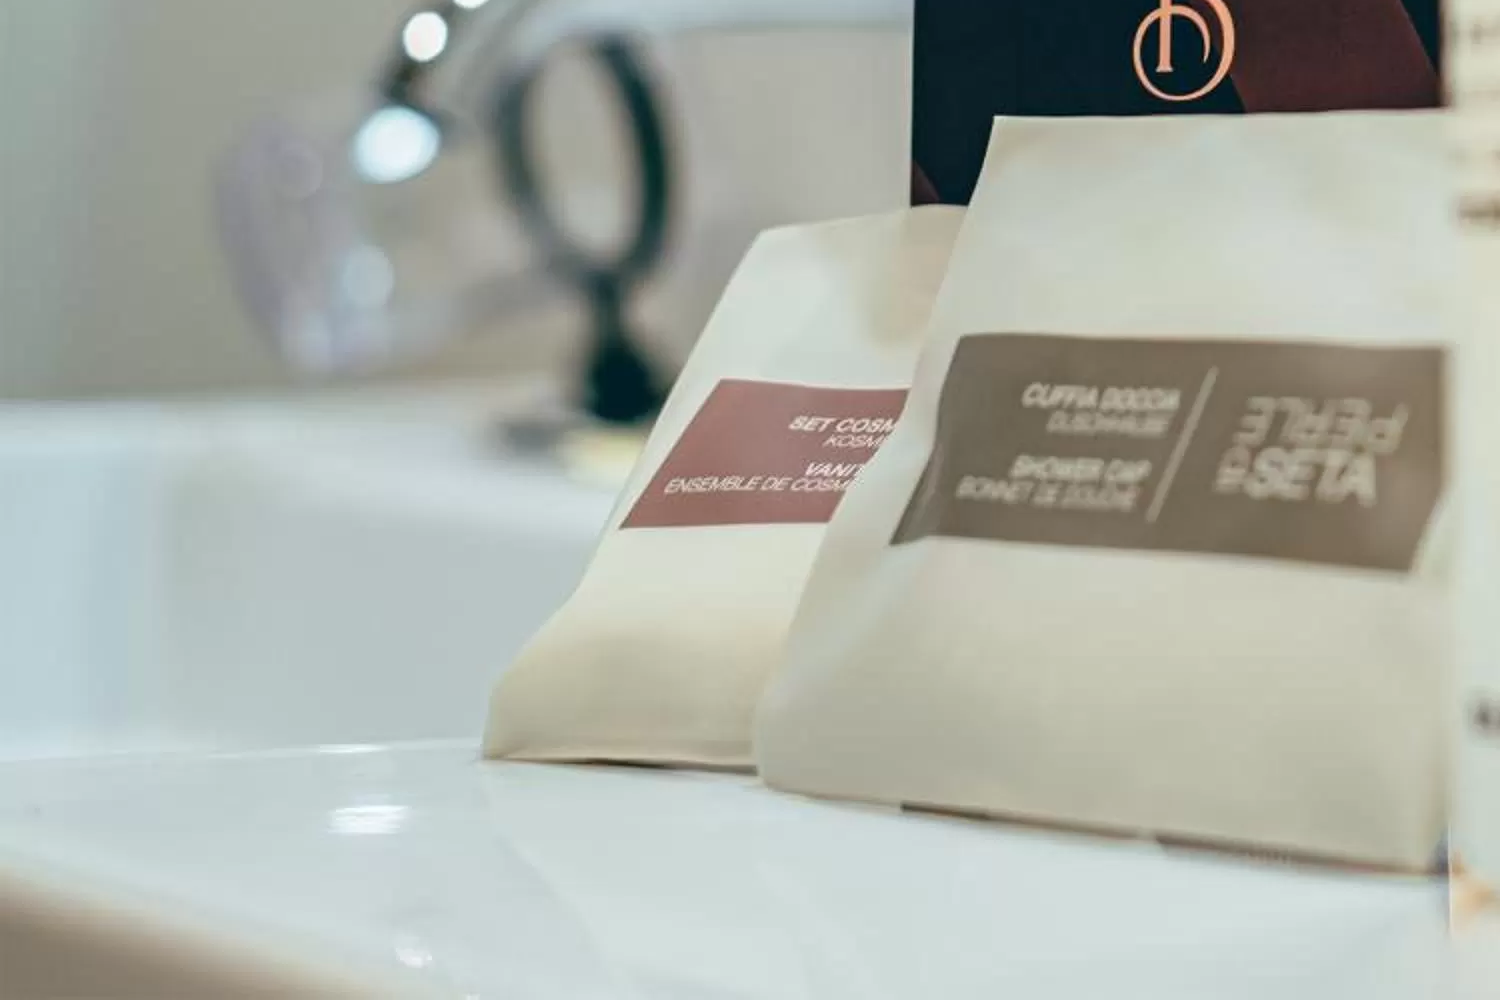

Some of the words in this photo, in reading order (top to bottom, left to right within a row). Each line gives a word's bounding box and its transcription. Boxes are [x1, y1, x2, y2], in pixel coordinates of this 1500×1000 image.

[788, 415, 837, 432] SET
[1010, 455, 1104, 481] SHOWER
[1244, 447, 1378, 508] SETA
[664, 475, 763, 493] ENSEMBLE
[761, 476, 793, 491] DE
